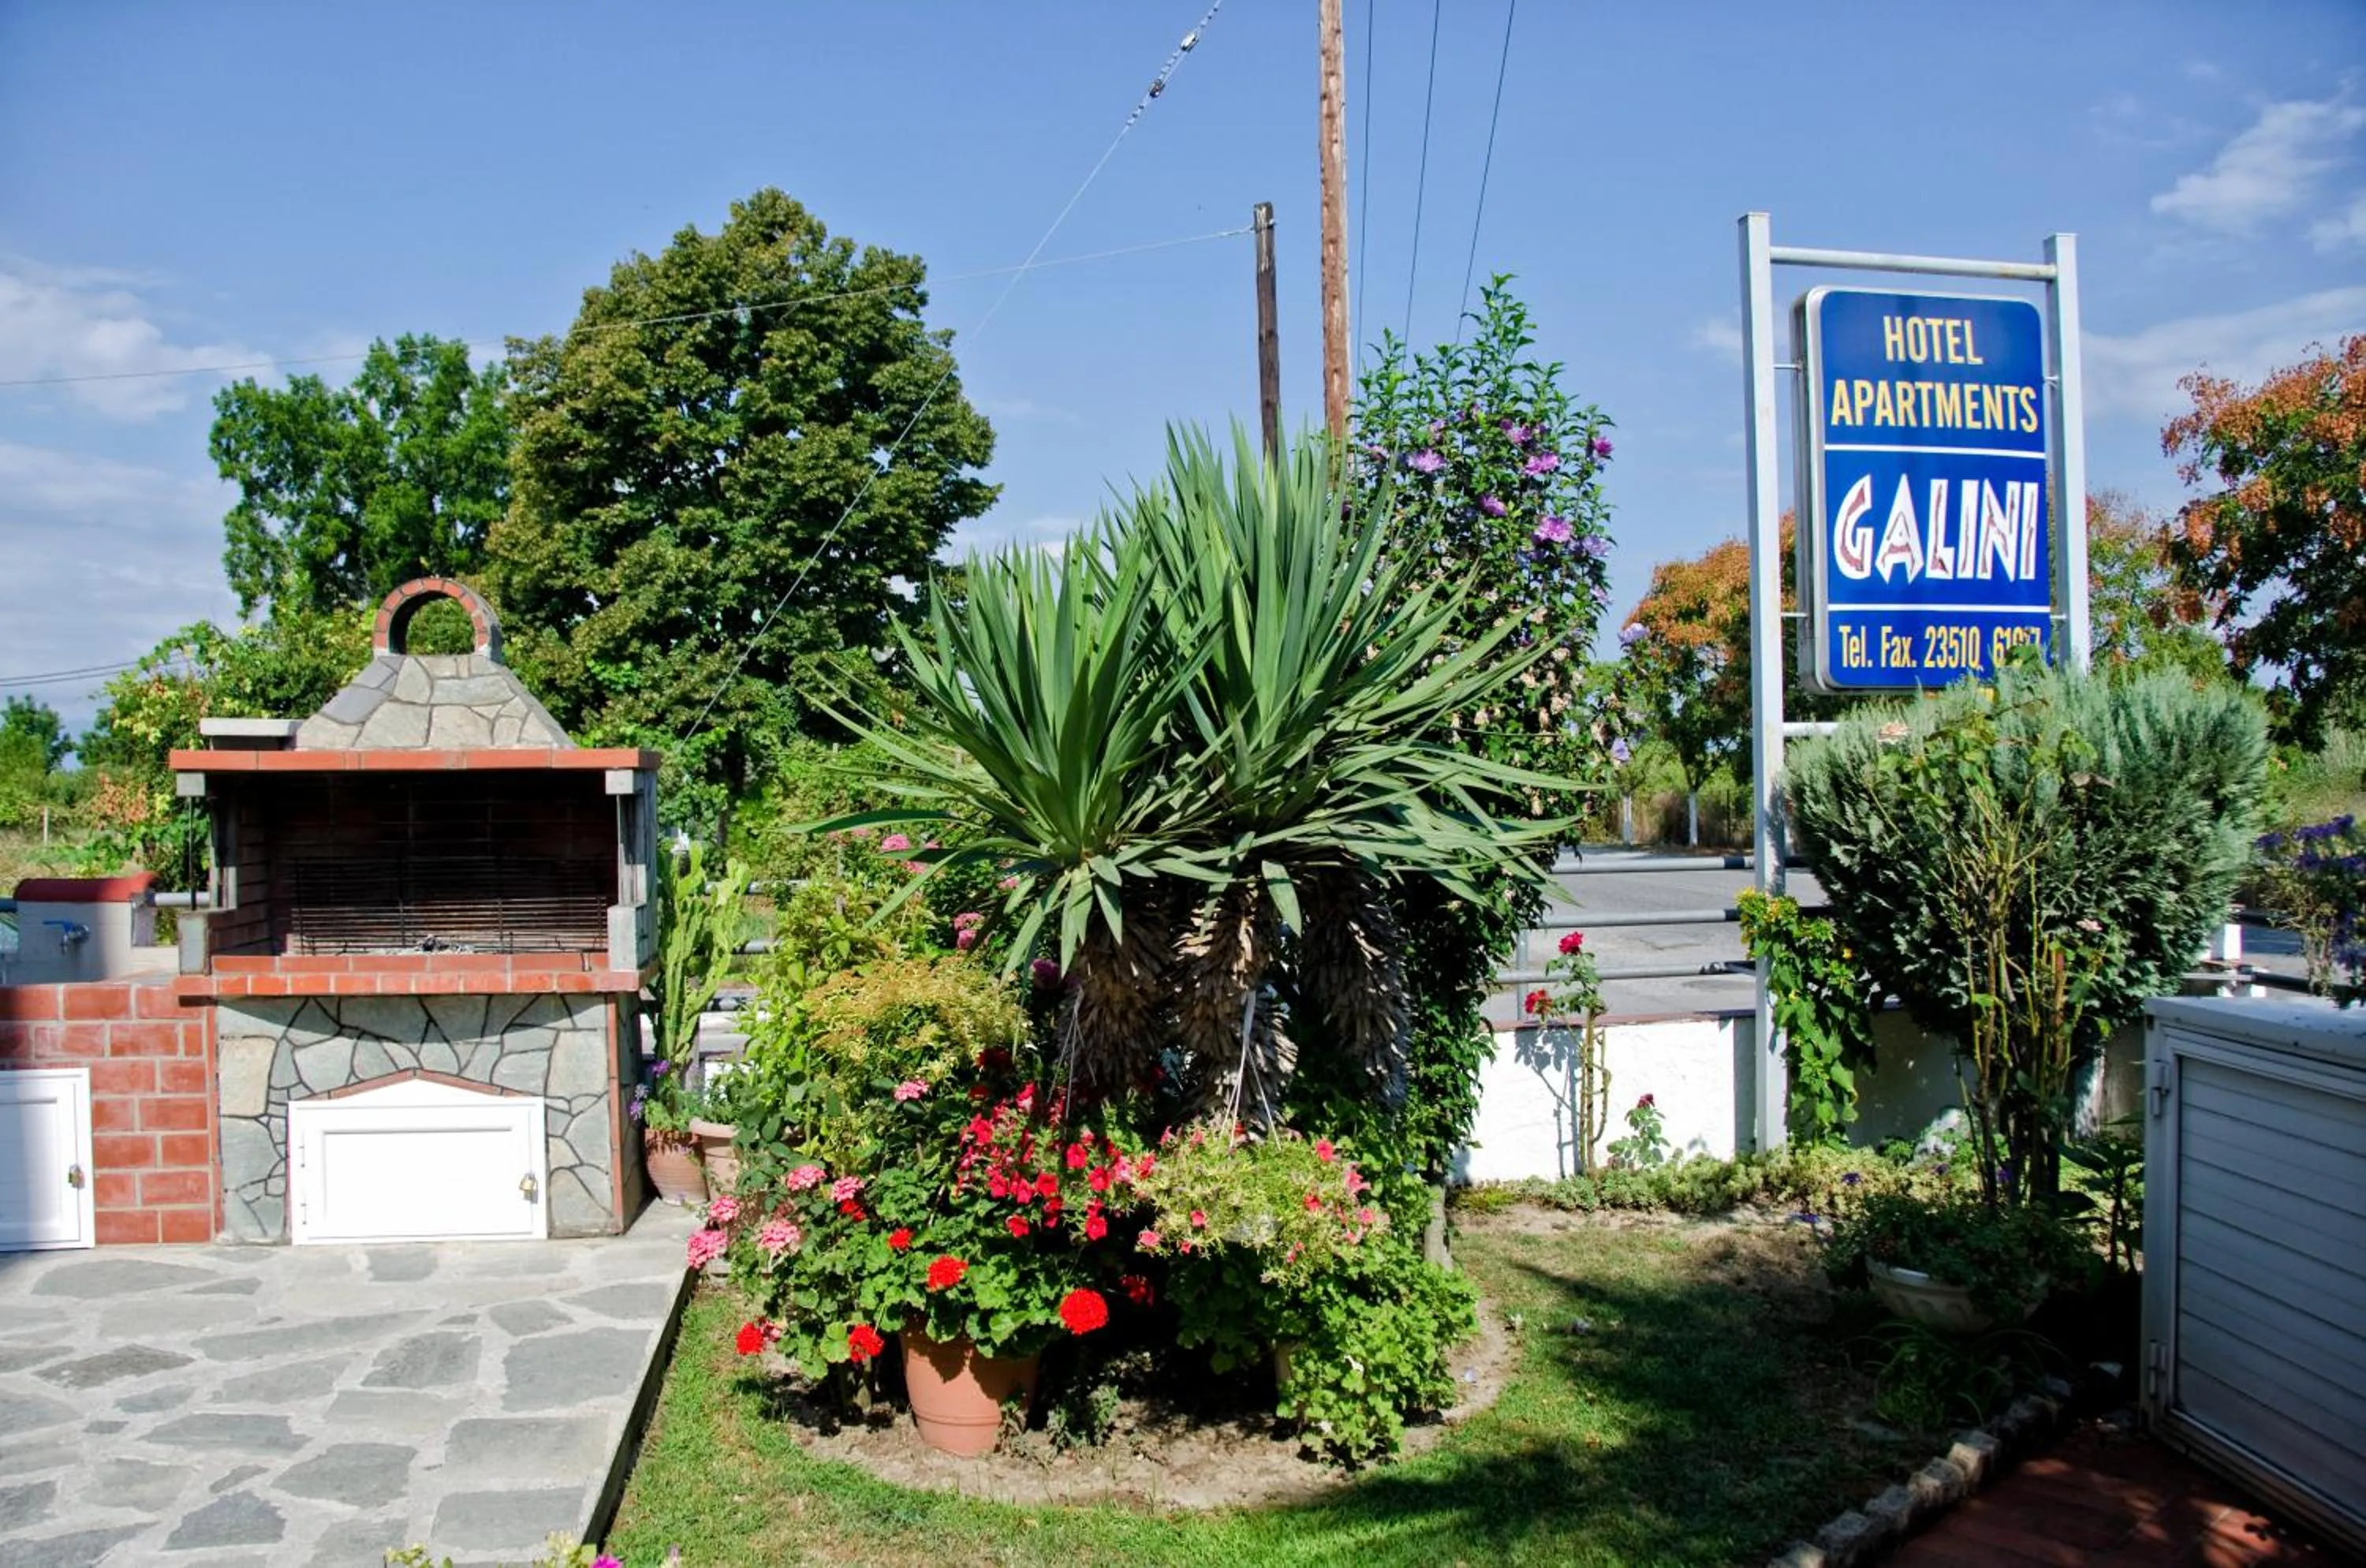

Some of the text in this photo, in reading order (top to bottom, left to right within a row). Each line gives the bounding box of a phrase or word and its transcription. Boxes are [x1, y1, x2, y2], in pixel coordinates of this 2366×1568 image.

[1883, 315, 1984, 365] HOTEL
[1830, 379, 2039, 433] APARTMENTS
[1834, 473, 2039, 584] GALINI
[1838, 625, 1873, 668] Tel.
[1880, 625, 1918, 668] Fax.
[1923, 625, 1981, 669] 23510
